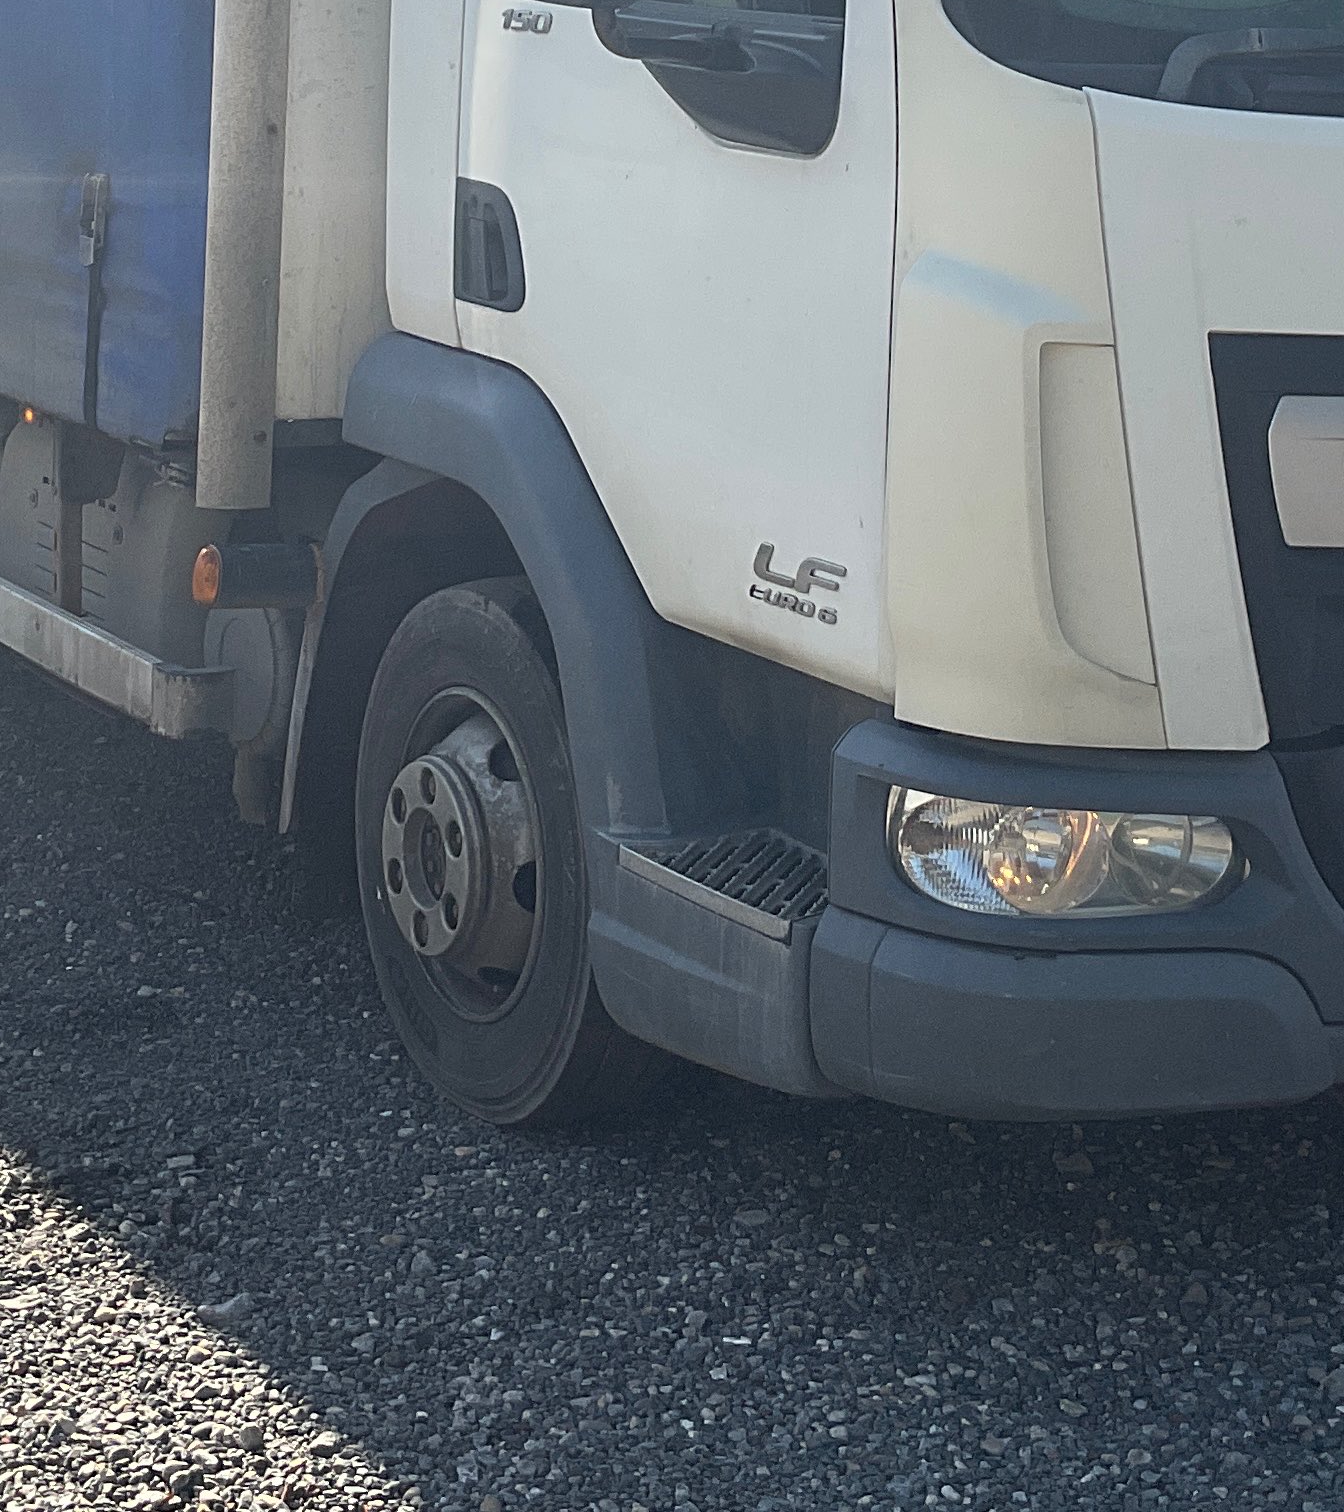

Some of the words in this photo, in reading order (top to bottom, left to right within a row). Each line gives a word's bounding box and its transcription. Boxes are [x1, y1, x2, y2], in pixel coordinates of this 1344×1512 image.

[501, 8, 554, 34] 150
[753, 541, 847, 594] LF
[749, 584, 816, 618] EURO
[818, 606, 838, 625] 6
